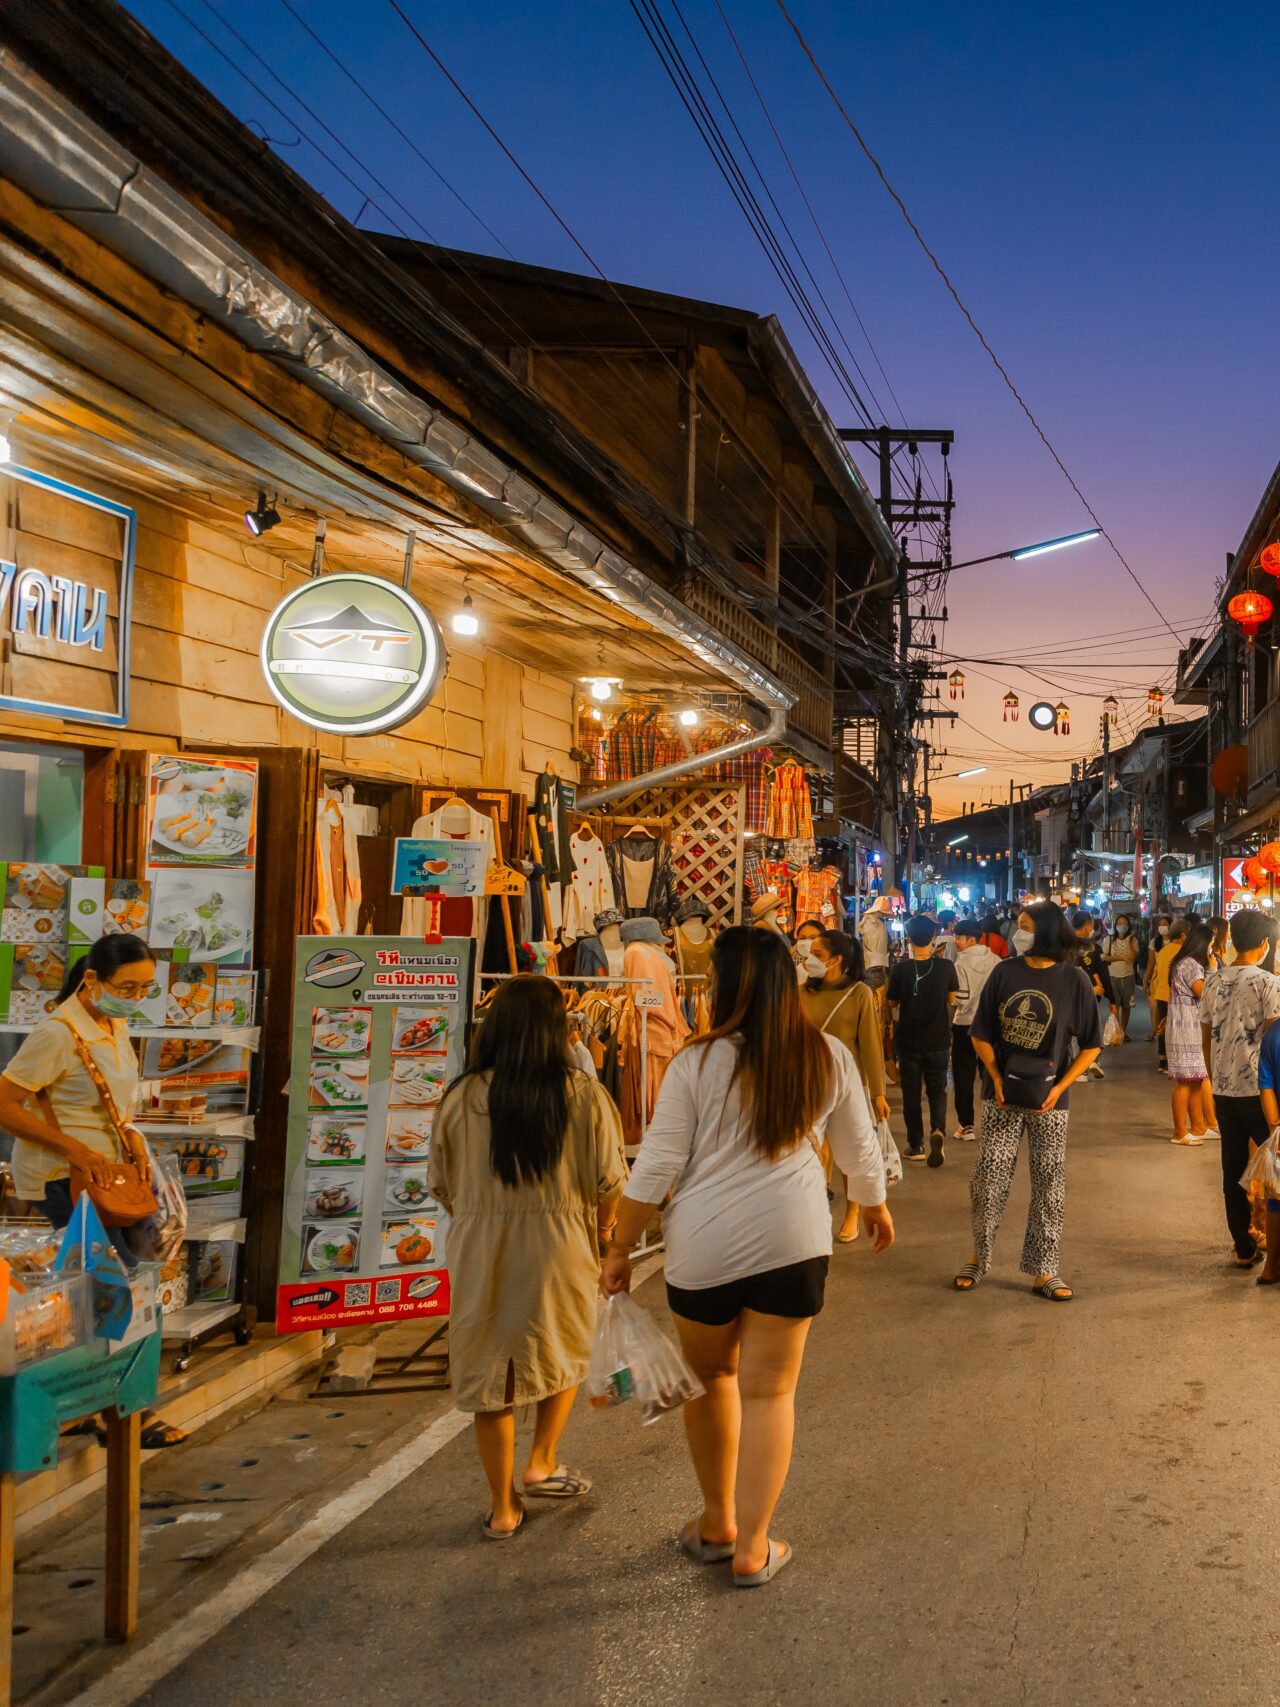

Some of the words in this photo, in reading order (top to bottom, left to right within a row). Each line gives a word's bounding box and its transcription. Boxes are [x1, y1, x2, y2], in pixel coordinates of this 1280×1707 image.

[378, 1306, 395, 1315] 088
[398, 1304, 415, 1312] 706
[416, 1300, 439, 1310] 4488
